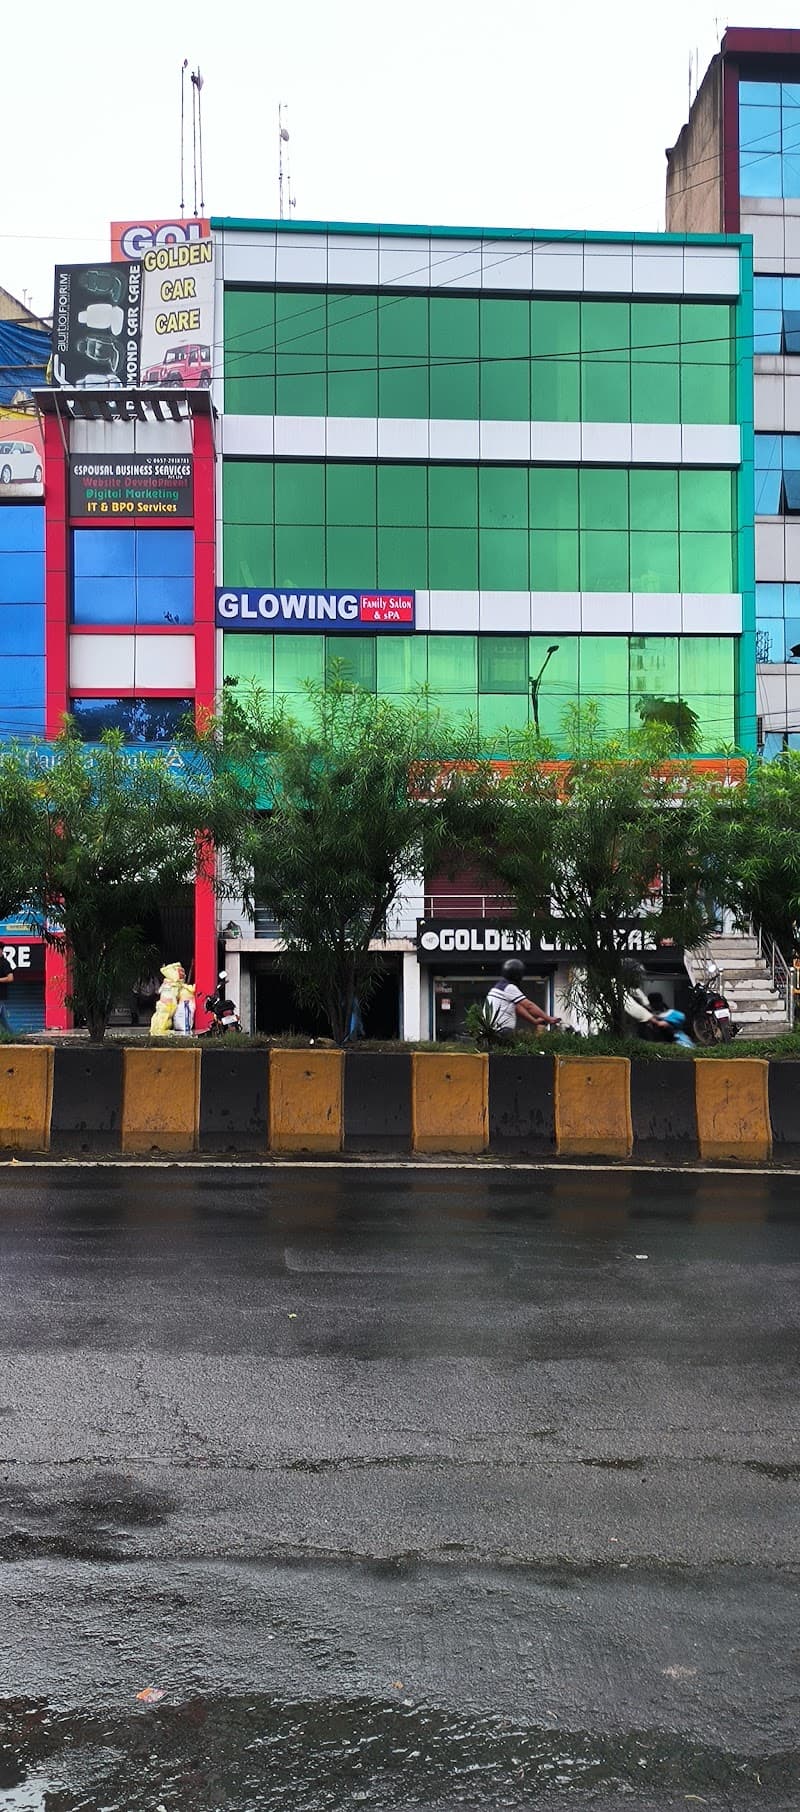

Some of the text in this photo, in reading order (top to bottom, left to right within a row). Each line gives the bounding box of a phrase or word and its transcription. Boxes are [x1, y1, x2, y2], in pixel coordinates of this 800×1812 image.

[143, 240, 213, 272] GOLDEN
[128, 264, 141, 305] CARE
[160, 276, 197, 303] CAR
[127, 306, 139, 337] CAR
[154, 307, 201, 336] CARE
[73, 465, 191, 476] ESPOUSAL BUSINESS SERVICES
[82, 477, 121, 488] Website
[85, 488, 179, 500] Digital Marketing
[87, 502, 177, 512] IT & BPO Services
[217, 593, 358, 620] GLOWING
[373, 611, 381, 620] &
[439, 928, 531, 951] GOLDEN
